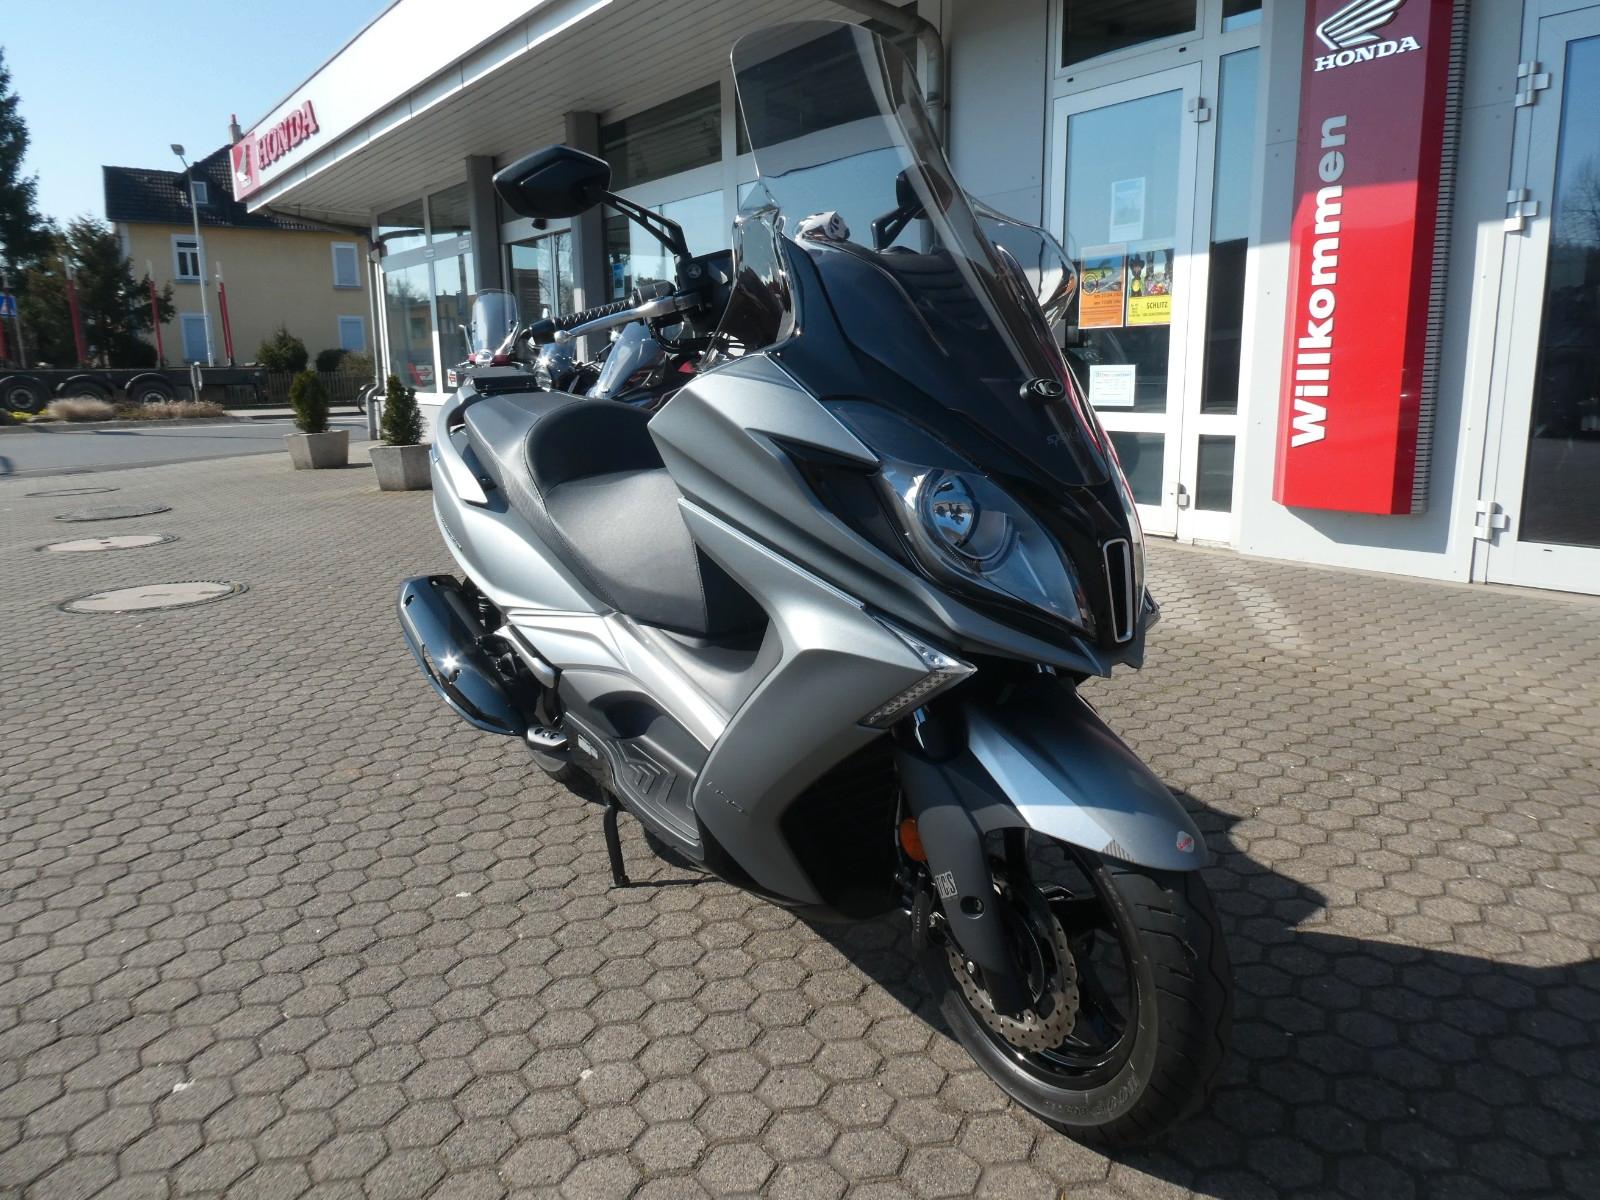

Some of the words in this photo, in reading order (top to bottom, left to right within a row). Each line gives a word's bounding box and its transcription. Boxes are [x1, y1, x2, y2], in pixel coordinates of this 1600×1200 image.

[1314, 36, 1421, 71] HONDA
[256, 100, 319, 170] HONDA
[1291, 114, 1348, 448] Willkommen
